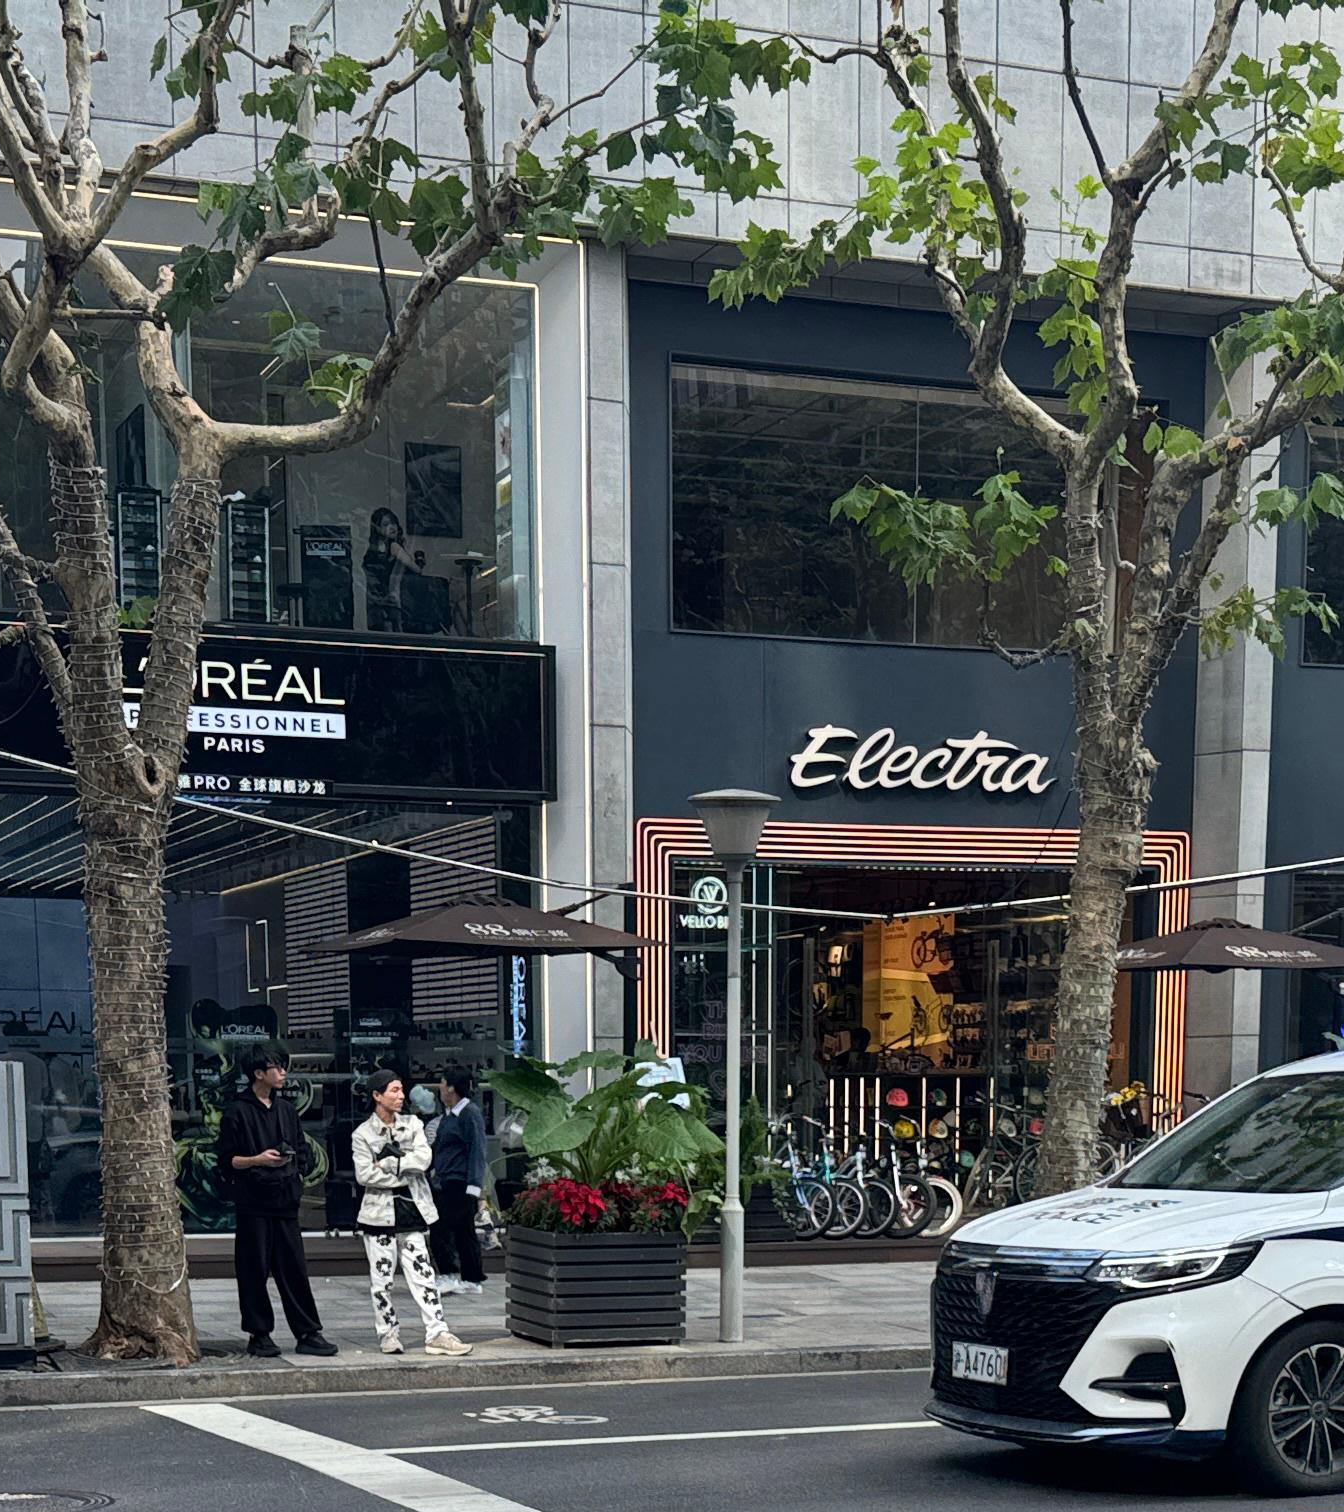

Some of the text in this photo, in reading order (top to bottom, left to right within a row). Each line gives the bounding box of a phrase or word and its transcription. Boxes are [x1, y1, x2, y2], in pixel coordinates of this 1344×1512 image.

[203, 736, 266, 754] PARIS
[790, 724, 1056, 794] Electra
[238, 779, 327, 796] 全球旗舰沙龙
[679, 915, 716, 929] VELLO
